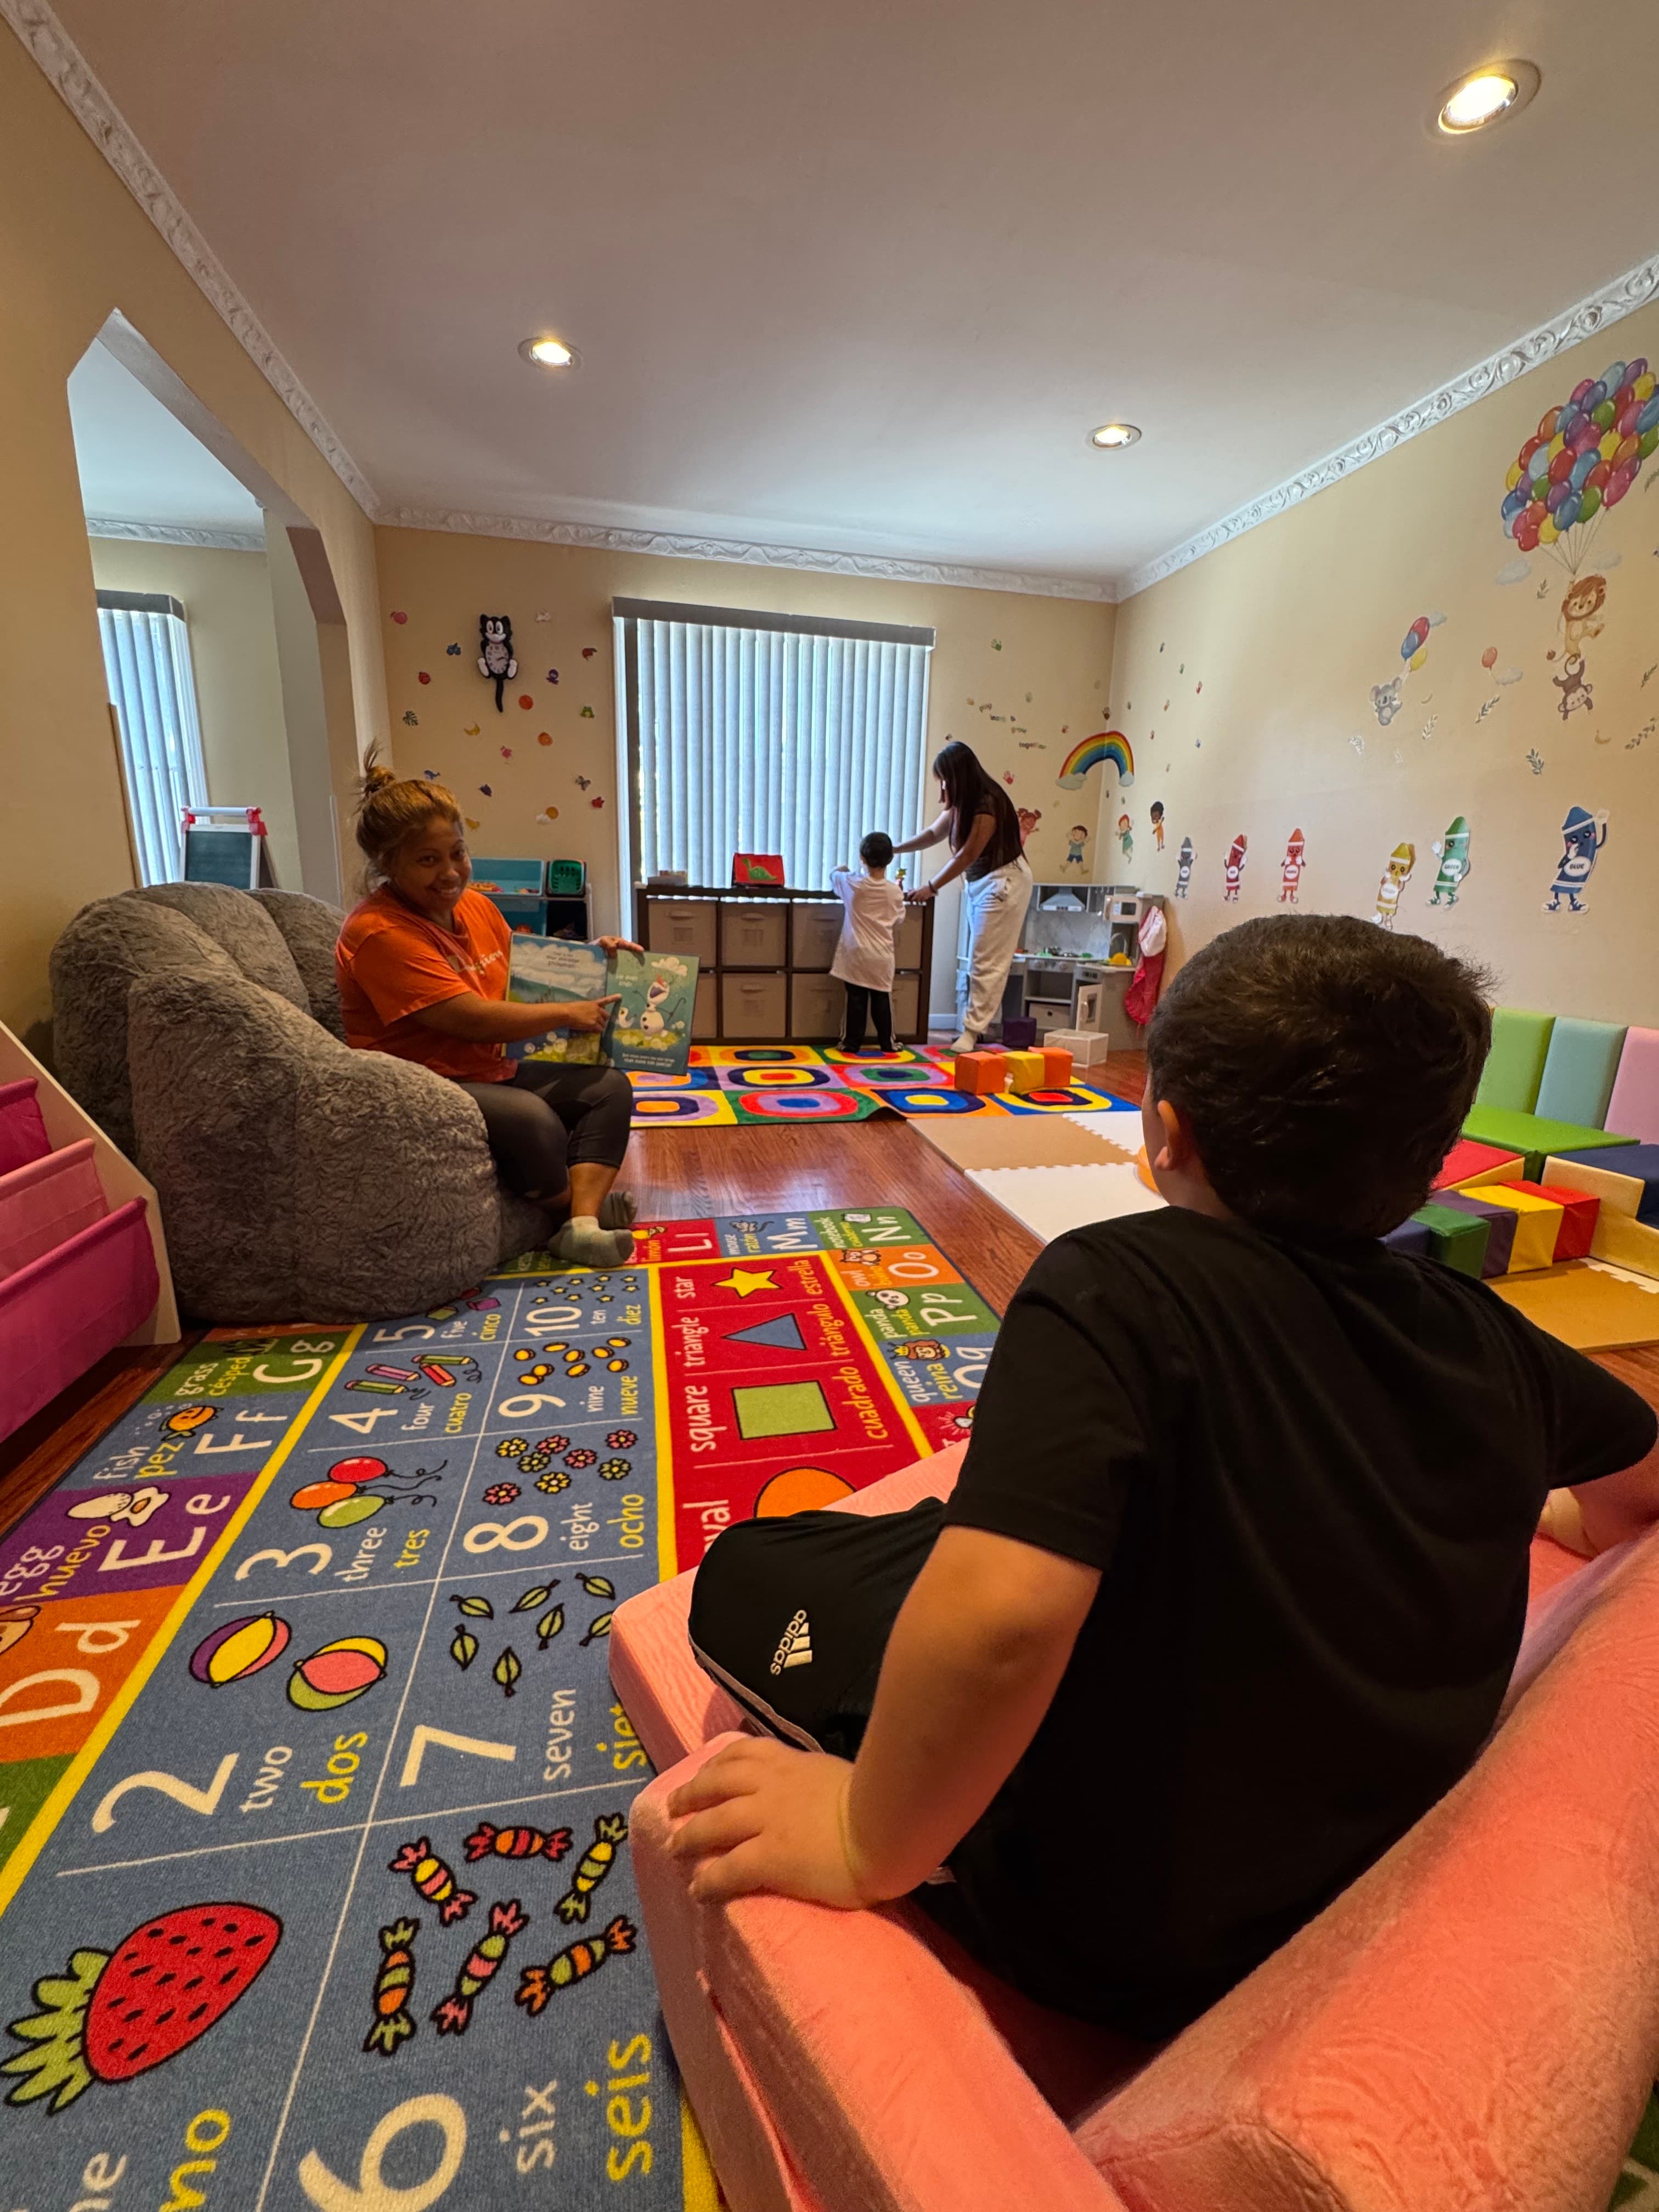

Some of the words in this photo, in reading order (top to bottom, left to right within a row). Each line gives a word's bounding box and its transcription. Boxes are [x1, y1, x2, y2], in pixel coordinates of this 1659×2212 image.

[724, 1234, 740, 1255] mouse
[814, 1216, 848, 1249] notebook
[674, 1276, 696, 1299] star
[787, 1260, 823, 1295] estrella
[840, 1269, 871, 1287] owl
[373, 1324, 436, 1342] 5
[441, 1321, 468, 1339] five
[471, 1314, 501, 1341] cinco
[524, 1306, 582, 1336] 10
[590, 1310, 607, 1325] ten
[617, 1304, 641, 1325] diez
[806, 1303, 851, 1357] triángulo
[865, 1308, 908, 1339] panda
[891, 1308, 931, 1336] panda
[671, 1316, 709, 1368] triangle
[174, 1362, 219, 1397] grass
[579, 1385, 605, 1413] nine
[620, 1375, 638, 1415] nueve
[894, 1361, 938, 1403] queen
[925, 1363, 963, 1400] reina
[329, 1408, 398, 1434] 4
[401, 1403, 435, 1431] four
[444, 1392, 473, 1434] cuatro
[498, 1394, 566, 1418] 9
[684, 1385, 727, 1453] square
[832, 1366, 889, 1440] cuadrado
[92, 1446, 151, 1480] fish
[133, 1442, 185, 1480] pez
[463, 1515, 549, 1554] 8
[560, 1502, 600, 1551] eight
[606, 1494, 645, 1549] ocho
[682, 1499, 731, 1553] val
[13, 1525, 111, 1601] huevo
[234, 1543, 332, 1581] 3
[334, 1527, 387, 1583] three
[393, 1528, 431, 1569] tres
[0, 1545, 65, 1596] egg
[770, 1610, 807, 1675] adidas
[543, 1689, 577, 1782] seven
[300, 1731, 368, 1804] dos
[399, 1724, 517, 1788] 7
[92, 1752, 240, 1834] 2
[239, 1746, 292, 1814] two
[499, 2079, 558, 2175] six
[584, 2033, 654, 2182] seis
[158, 2108, 231, 2212] no
[298, 2093, 467, 2212] 6
